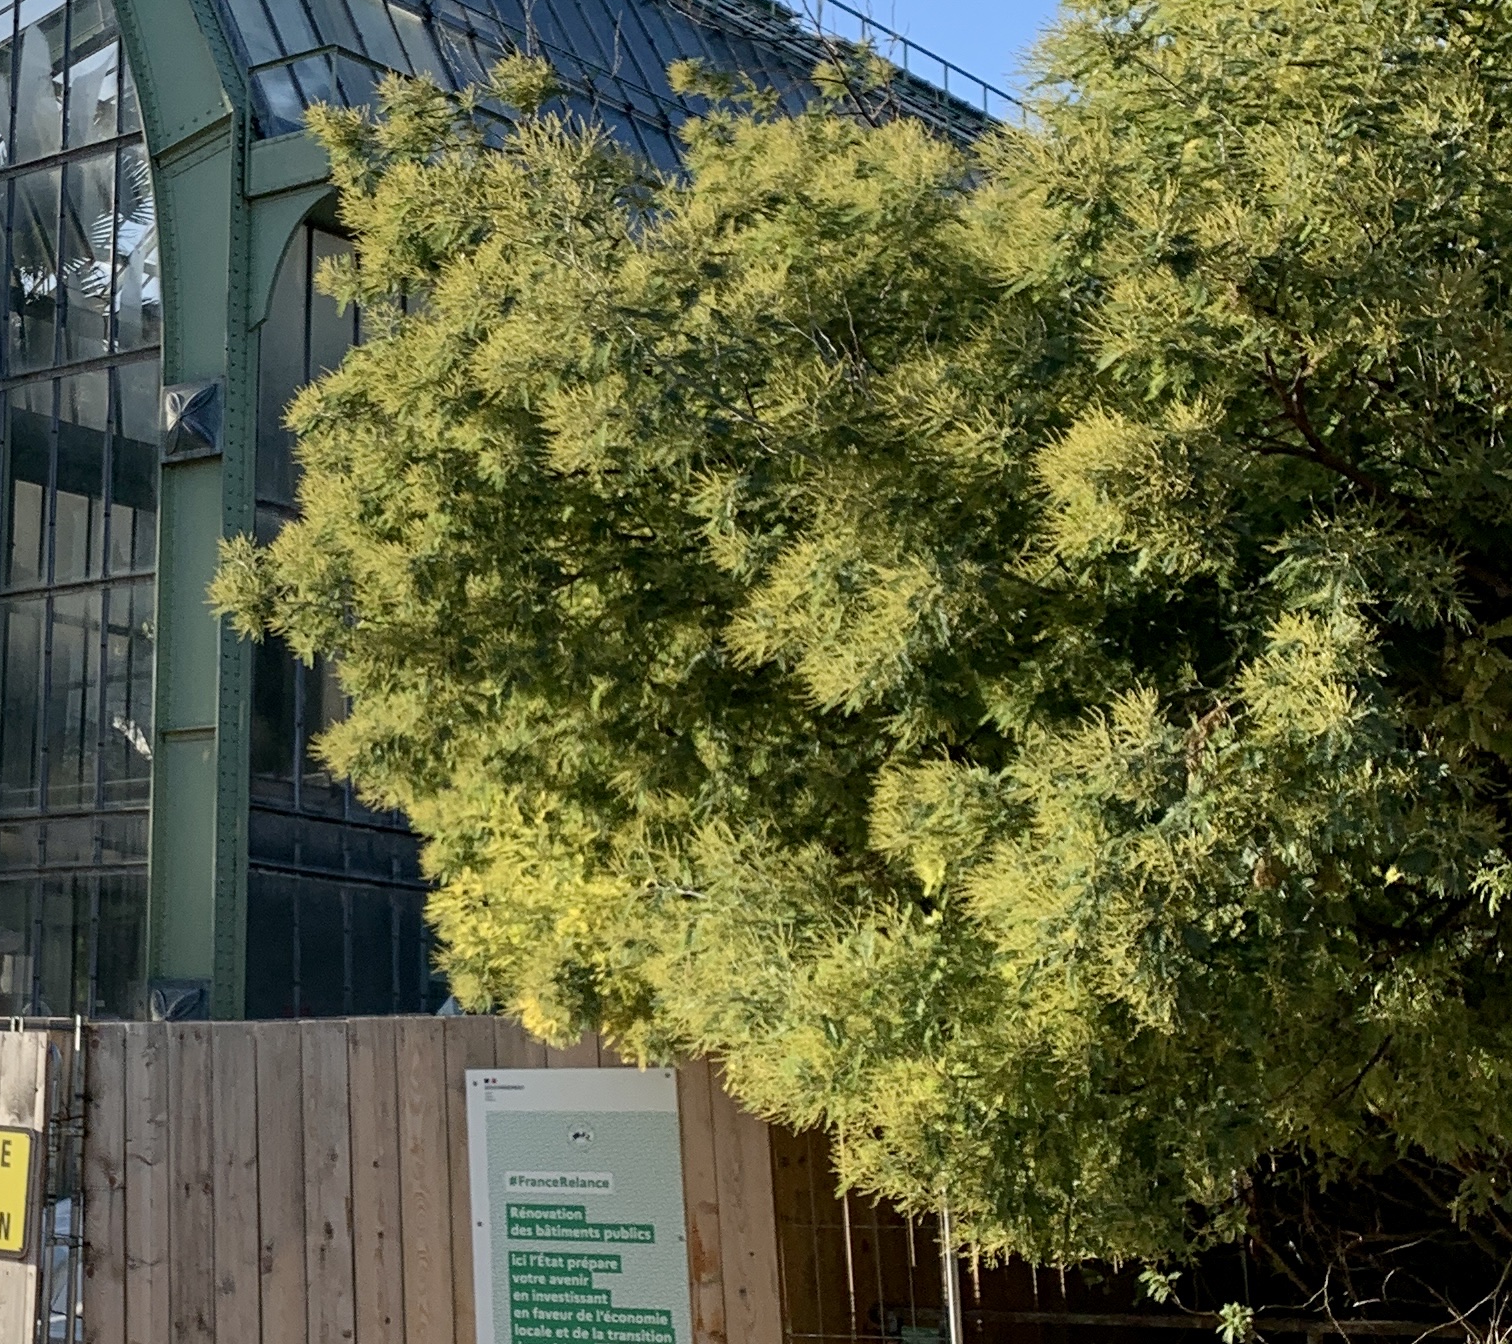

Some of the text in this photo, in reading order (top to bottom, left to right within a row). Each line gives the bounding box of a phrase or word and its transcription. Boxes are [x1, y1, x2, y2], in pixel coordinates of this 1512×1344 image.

[508, 1175, 610, 1189] #FranceRelance
[510, 1206, 583, 1220] Rénovation
[510, 1224, 652, 1242] des bâtiments publics
[511, 1253, 619, 1271] Ici l'État prépare
[512, 1273, 590, 1287] votre avenir
[513, 1289, 609, 1305] en investissant
[513, 1307, 669, 1325] en faveur de l'économie
[514, 1324, 673, 1344] locale et de la transition
